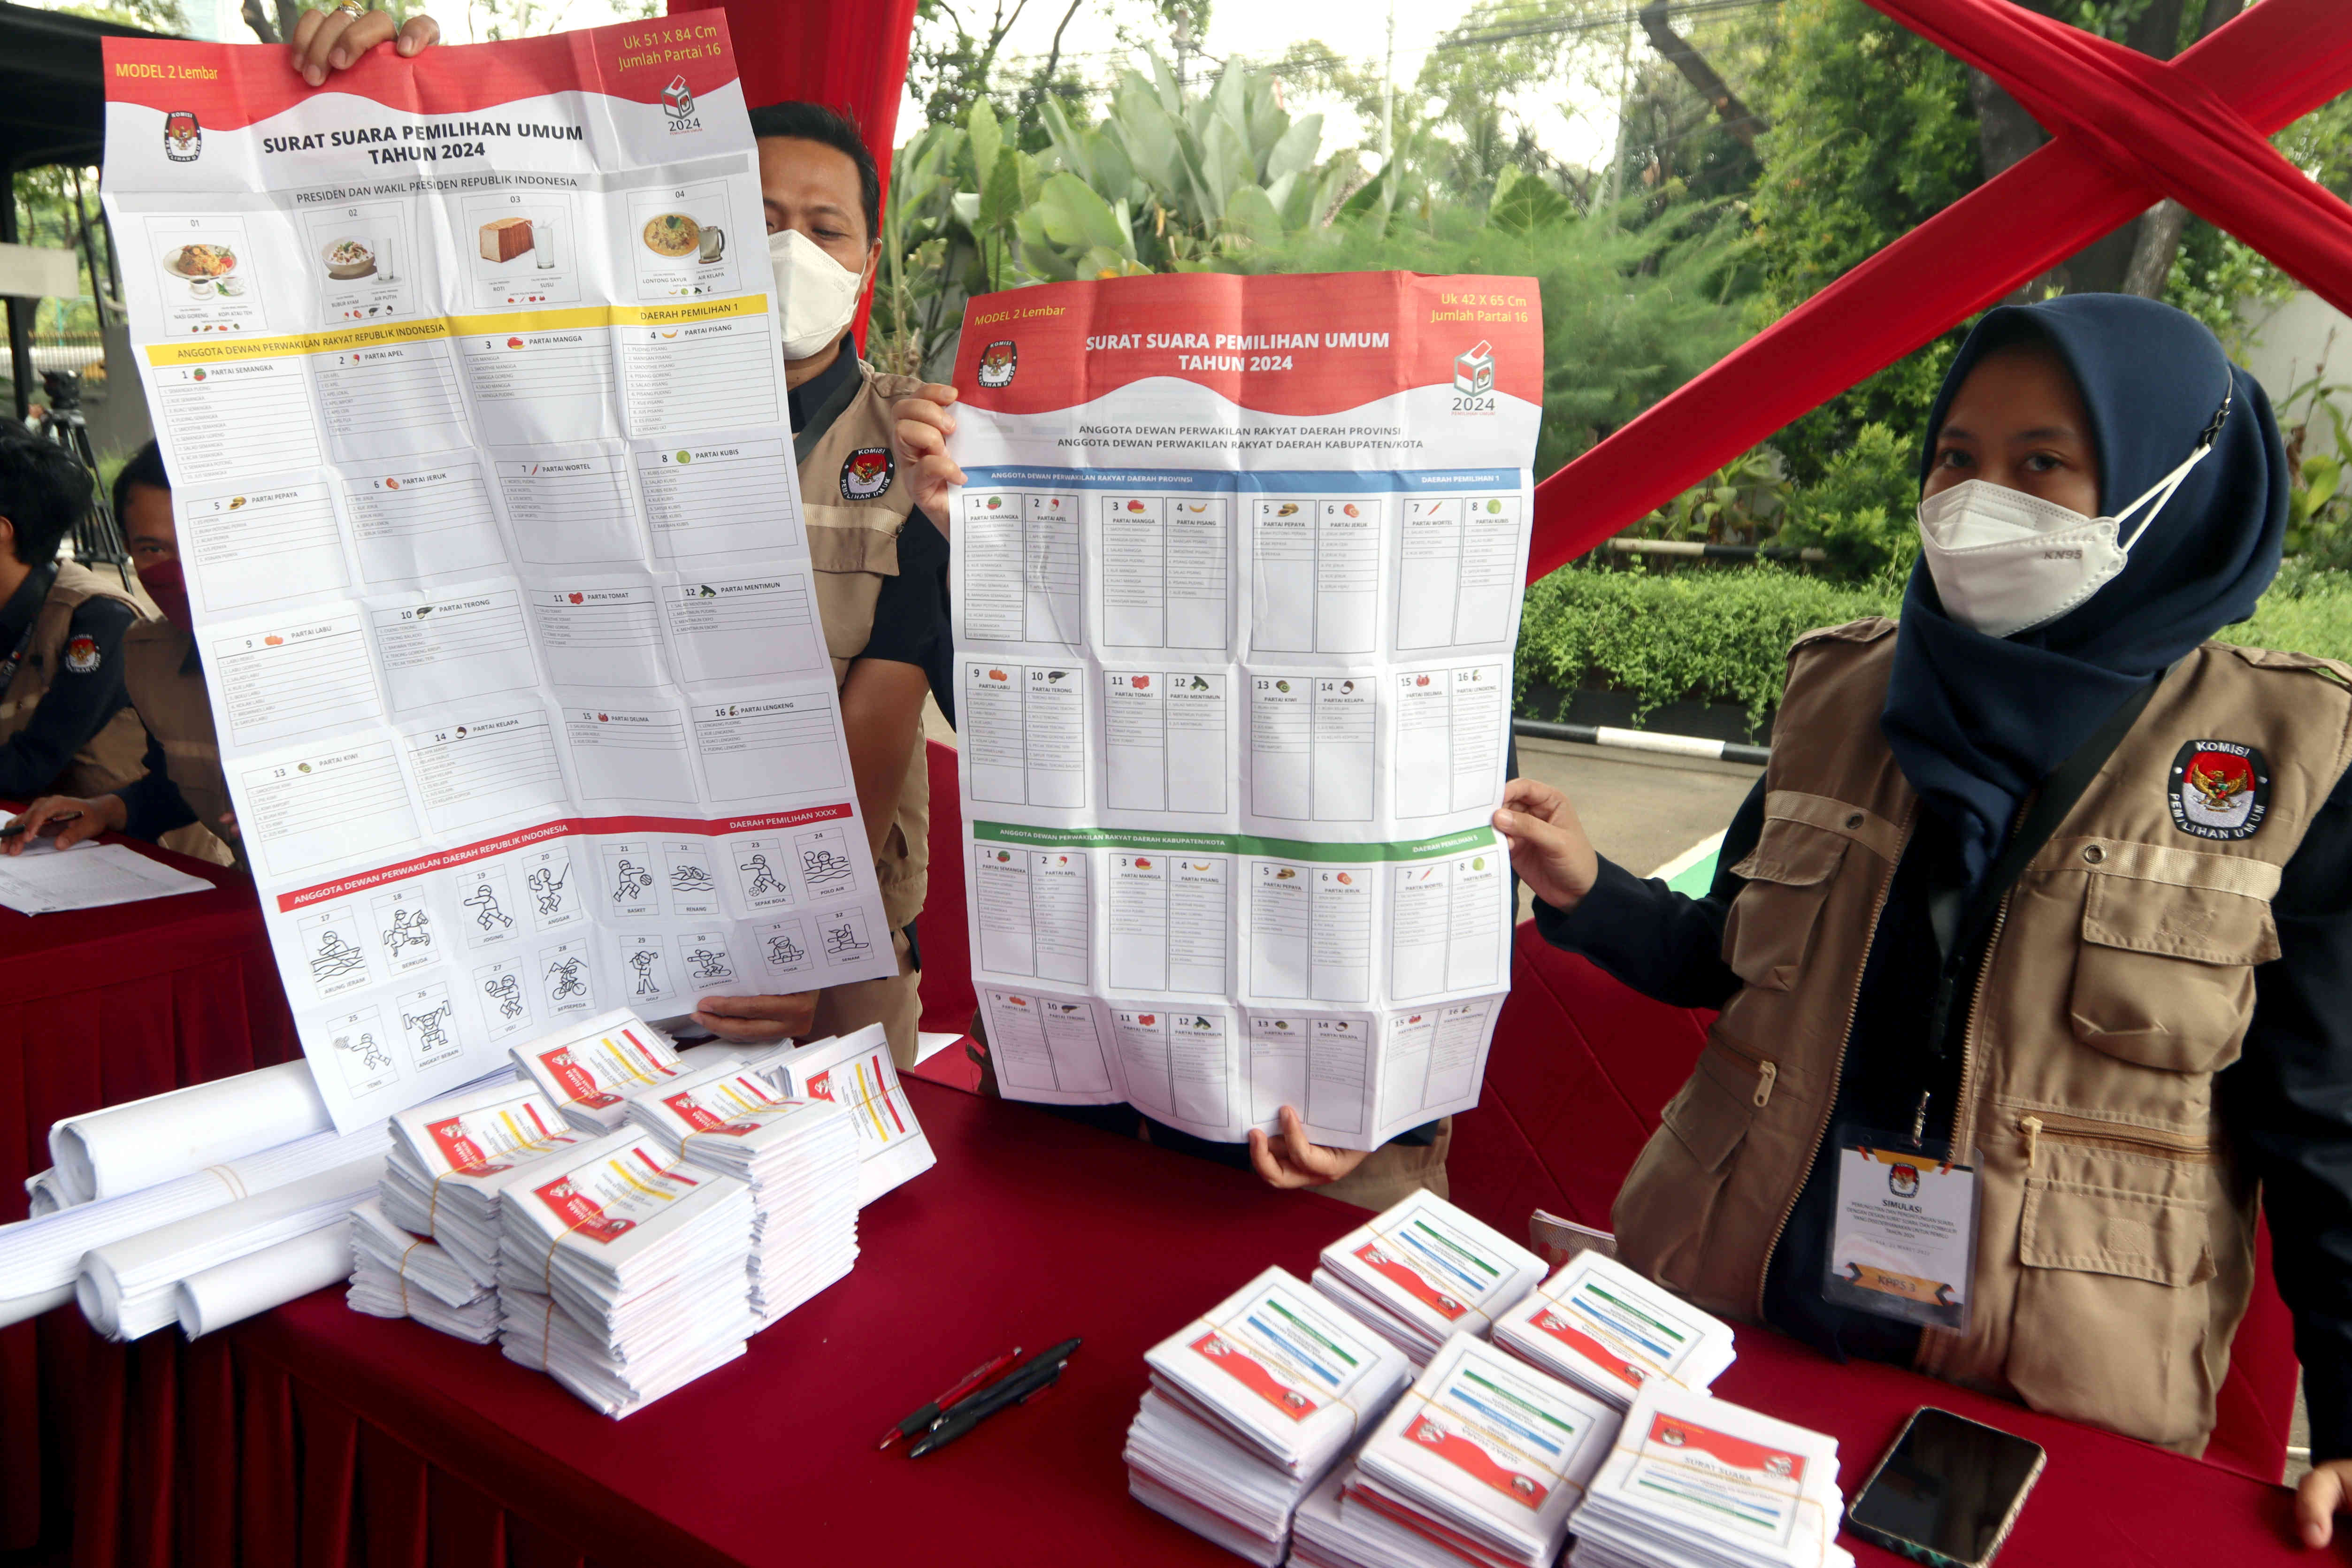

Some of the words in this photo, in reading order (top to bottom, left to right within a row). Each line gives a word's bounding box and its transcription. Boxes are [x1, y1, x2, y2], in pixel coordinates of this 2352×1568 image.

[623, 35, 641, 50] Uk
[644, 33, 659, 47] 51
[662, 31, 673, 44] X
[675, 29, 692, 41] 84
[695, 24, 717, 38] Cm
[618, 52, 662, 71] Jumlah
[665, 46, 703, 64] Partai
[705, 42, 721, 56] 16
[116, 64, 165, 78] MODEL
[168, 65, 175, 78] 2
[178, 66, 218, 80] Lembar
[668, 117, 701, 131] 2024
[263, 133, 325, 153] SURAT
[331, 126, 397, 147] SUARA
[403, 122, 510, 140] PEMILIHAN
[518, 123, 583, 140] UMUM
[165, 141, 190, 162] PEMILIHAN
[191, 139, 202, 161] UMUM
[368, 146, 437, 164] TAHUN
[441, 142, 485, 157] 2024
[296, 189, 346, 203] PRESIDEN
[348, 186, 371, 197] DAN
[374, 183, 406, 194] WAKIL
[409, 178, 458, 191] PRESIDEN
[460, 175, 512, 187] REPUBLIK
[514, 175, 577, 186] INDONESIA
[348, 208, 358, 217] 02
[191, 219, 199, 228] 01
[1441, 293, 1457, 305] Uk
[1461, 294, 1476, 305] 42
[1479, 295, 1487, 305] X
[1490, 295, 1504, 306] 65
[1507, 295, 1526, 306] Cm
[640, 309, 679, 321] DAERAH
[681, 304, 732, 317] PEMILIHAN
[734, 304, 738, 312] 1
[974, 311, 1011, 326] MODEL
[1012, 309, 1020, 319] 2
[1023, 306, 1066, 318] Lembar
[1431, 310, 1474, 323] Jumlah
[1477, 312, 1512, 323] Partai
[1515, 312, 1528, 322] 16
[650, 331, 656, 340] 4
[709, 324, 732, 333] PISANG
[177, 346, 223, 359] ANGGOTA
[226, 343, 261, 355] DEWAN
[263, 338, 320, 352] PERWAKILAN
[322, 334, 353, 346] RAKYAT
[355, 329, 393, 342] REPUBLIK
[396, 323, 445, 338] INDONESIA
[485, 341, 491, 349] 3
[529, 337, 551, 345] PARTAI
[552, 335, 582, 344] MANGGA
[1086, 333, 1142, 351] SURAT
[1146, 332, 1210, 349] SUARA
[1215, 332, 1319, 350] PEMILIHAN
[1325, 332, 1390, 348] UMUM
[1179, 354, 1244, 371] TAHUN
[1249, 355, 1293, 371] 2024
[182, 371, 187, 379] 1
[235, 365, 273, 374] SEMANGKA
[978, 367, 1002, 388] PEMILIHAN
[1003, 366, 1016, 386] UMUM
[1453, 398, 1495, 411] 2024
[1079, 425, 1132, 435] ANGGOTA
[1135, 426, 1175, 435] DEWAN
[1179, 426, 1250, 436] PERWAKILAN
[1254, 427, 1297, 436] RAKYAT
[1300, 427, 1346, 436] DAERAH
[1349, 427, 1401, 436] PROVINSI
[1057, 438, 1110, 447] ANGGOTA
[1112, 439, 1153, 447] DEWAN
[1156, 439, 1228, 448] PERWAKILAN
[1231, 440, 1273, 449] RAKYAT
[1276, 440, 1322, 449] DAERAH
[1325, 440, 1423, 449] KABUPATEN/KOTA
[841, 479, 870, 499] PEMILIHAN
[873, 478, 891, 497] UMUM
[1113, 502, 1119, 511] 3
[2044, 550, 2082, 560] KN95
[686, 588, 695, 597] 12
[744, 581, 780, 591] MENTIMUN
[1174, 679, 1185, 687] 12
[2196, 741, 2251, 756] KOMISI
[729, 818, 764, 829] DAERAH
[766, 813, 814, 826] PEMILIHAN
[814, 809, 837, 818] XXXX
[2168, 793, 2229, 838] PEMILIHAN
[2234, 805, 2266, 838] UMUM
[1413, 844, 1440, 853] DAERAH
[1440, 837, 1473, 848] PEMILIHAN
[293, 883, 342, 904] ANGGOTA
[344, 874, 379, 891] DEWAN
[382, 859, 440, 880] PERWAKILAN
[442, 848, 478, 864] DAERAH
[480, 836, 520, 855] REPUBLIK
[521, 825, 568, 843] INDONESIA
[419, 1057, 439, 1068] ANGKAT
[440, 1049, 459, 1060] BEBAN
[1882, 1200, 1922, 1213] SIMULASI
[1877, 1275, 1907, 1290] KPPS
[1910, 1283, 1916, 1292] 3
